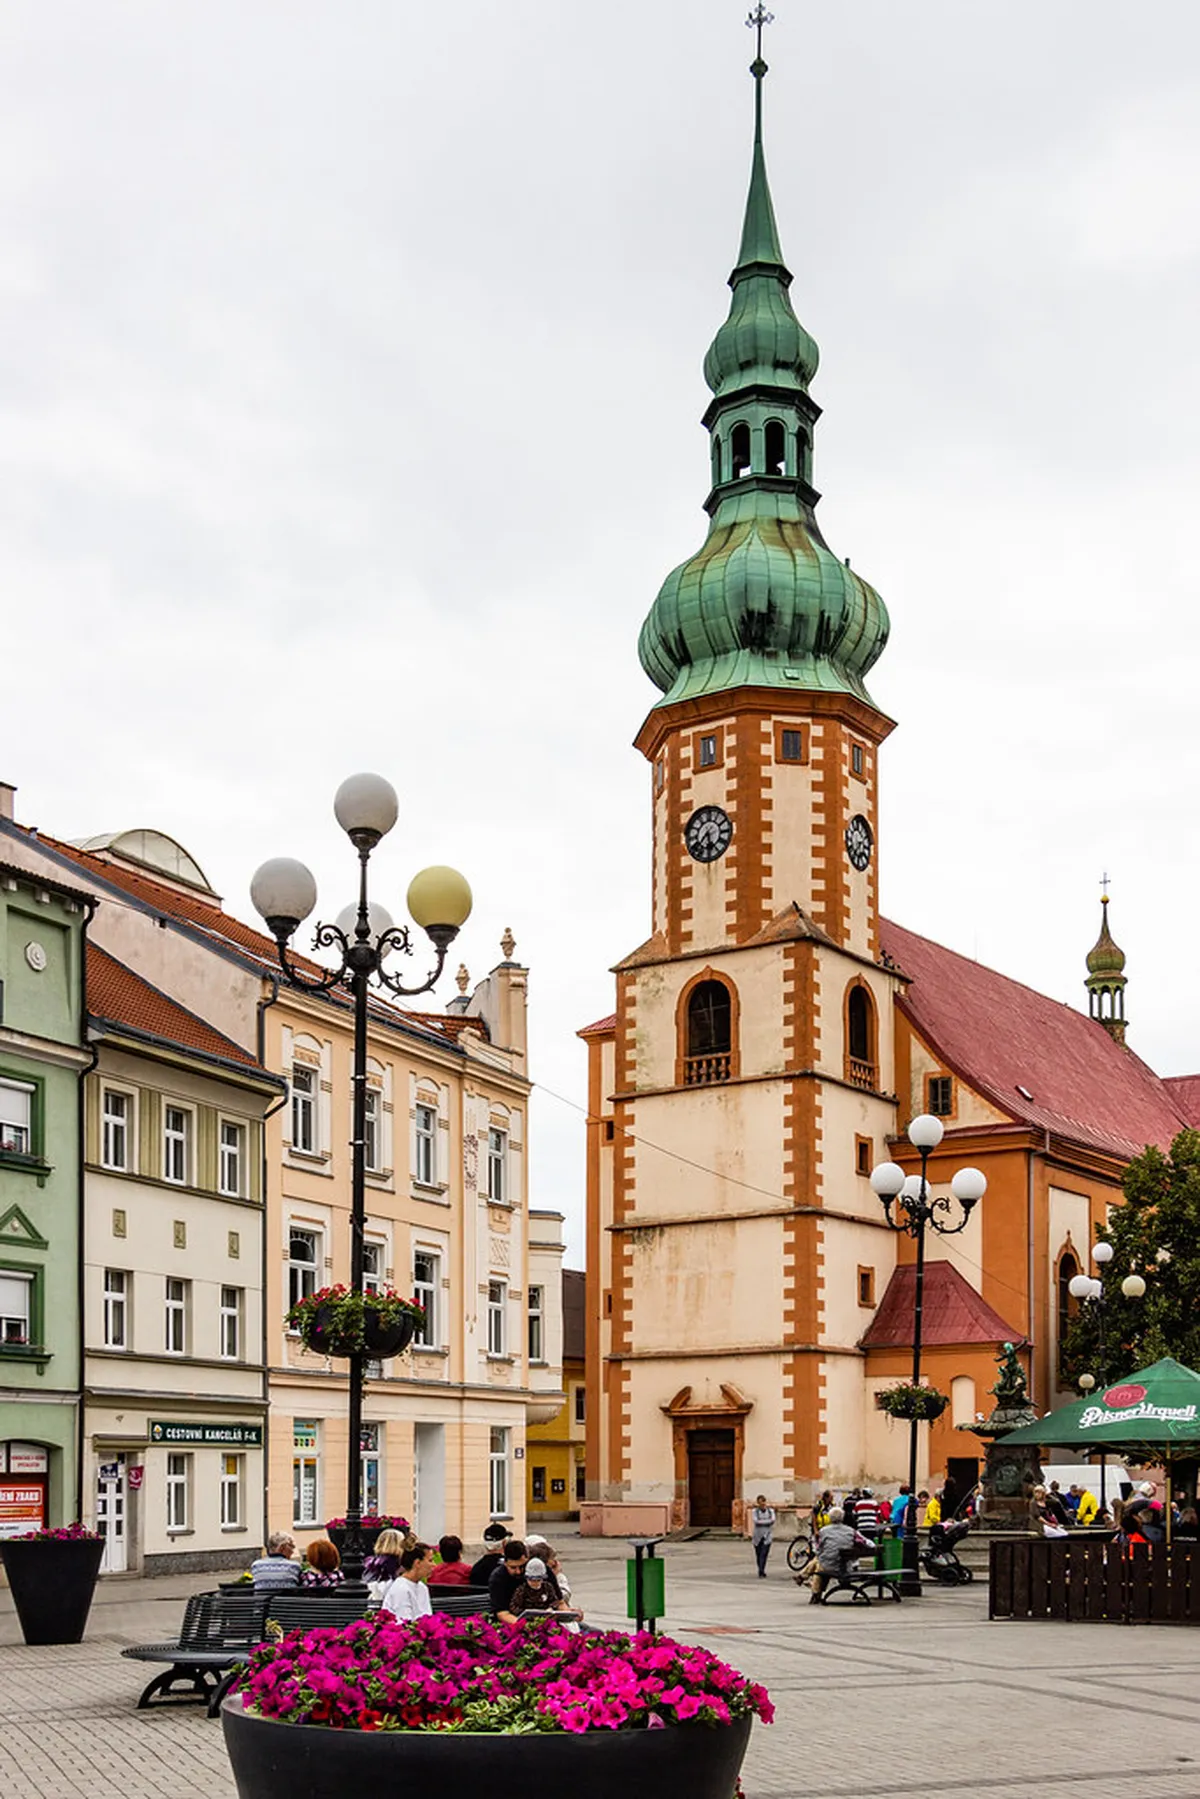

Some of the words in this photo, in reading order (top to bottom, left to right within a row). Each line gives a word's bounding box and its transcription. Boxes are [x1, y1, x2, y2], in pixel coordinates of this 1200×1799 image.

[1079, 1406, 1140, 1429] Pilsner
[1139, 1402, 1197, 1421] Urquell
[166, 1426, 203, 1440] CESTOVNÍ
[205, 1428, 242, 1441] KANCELÁŘ
